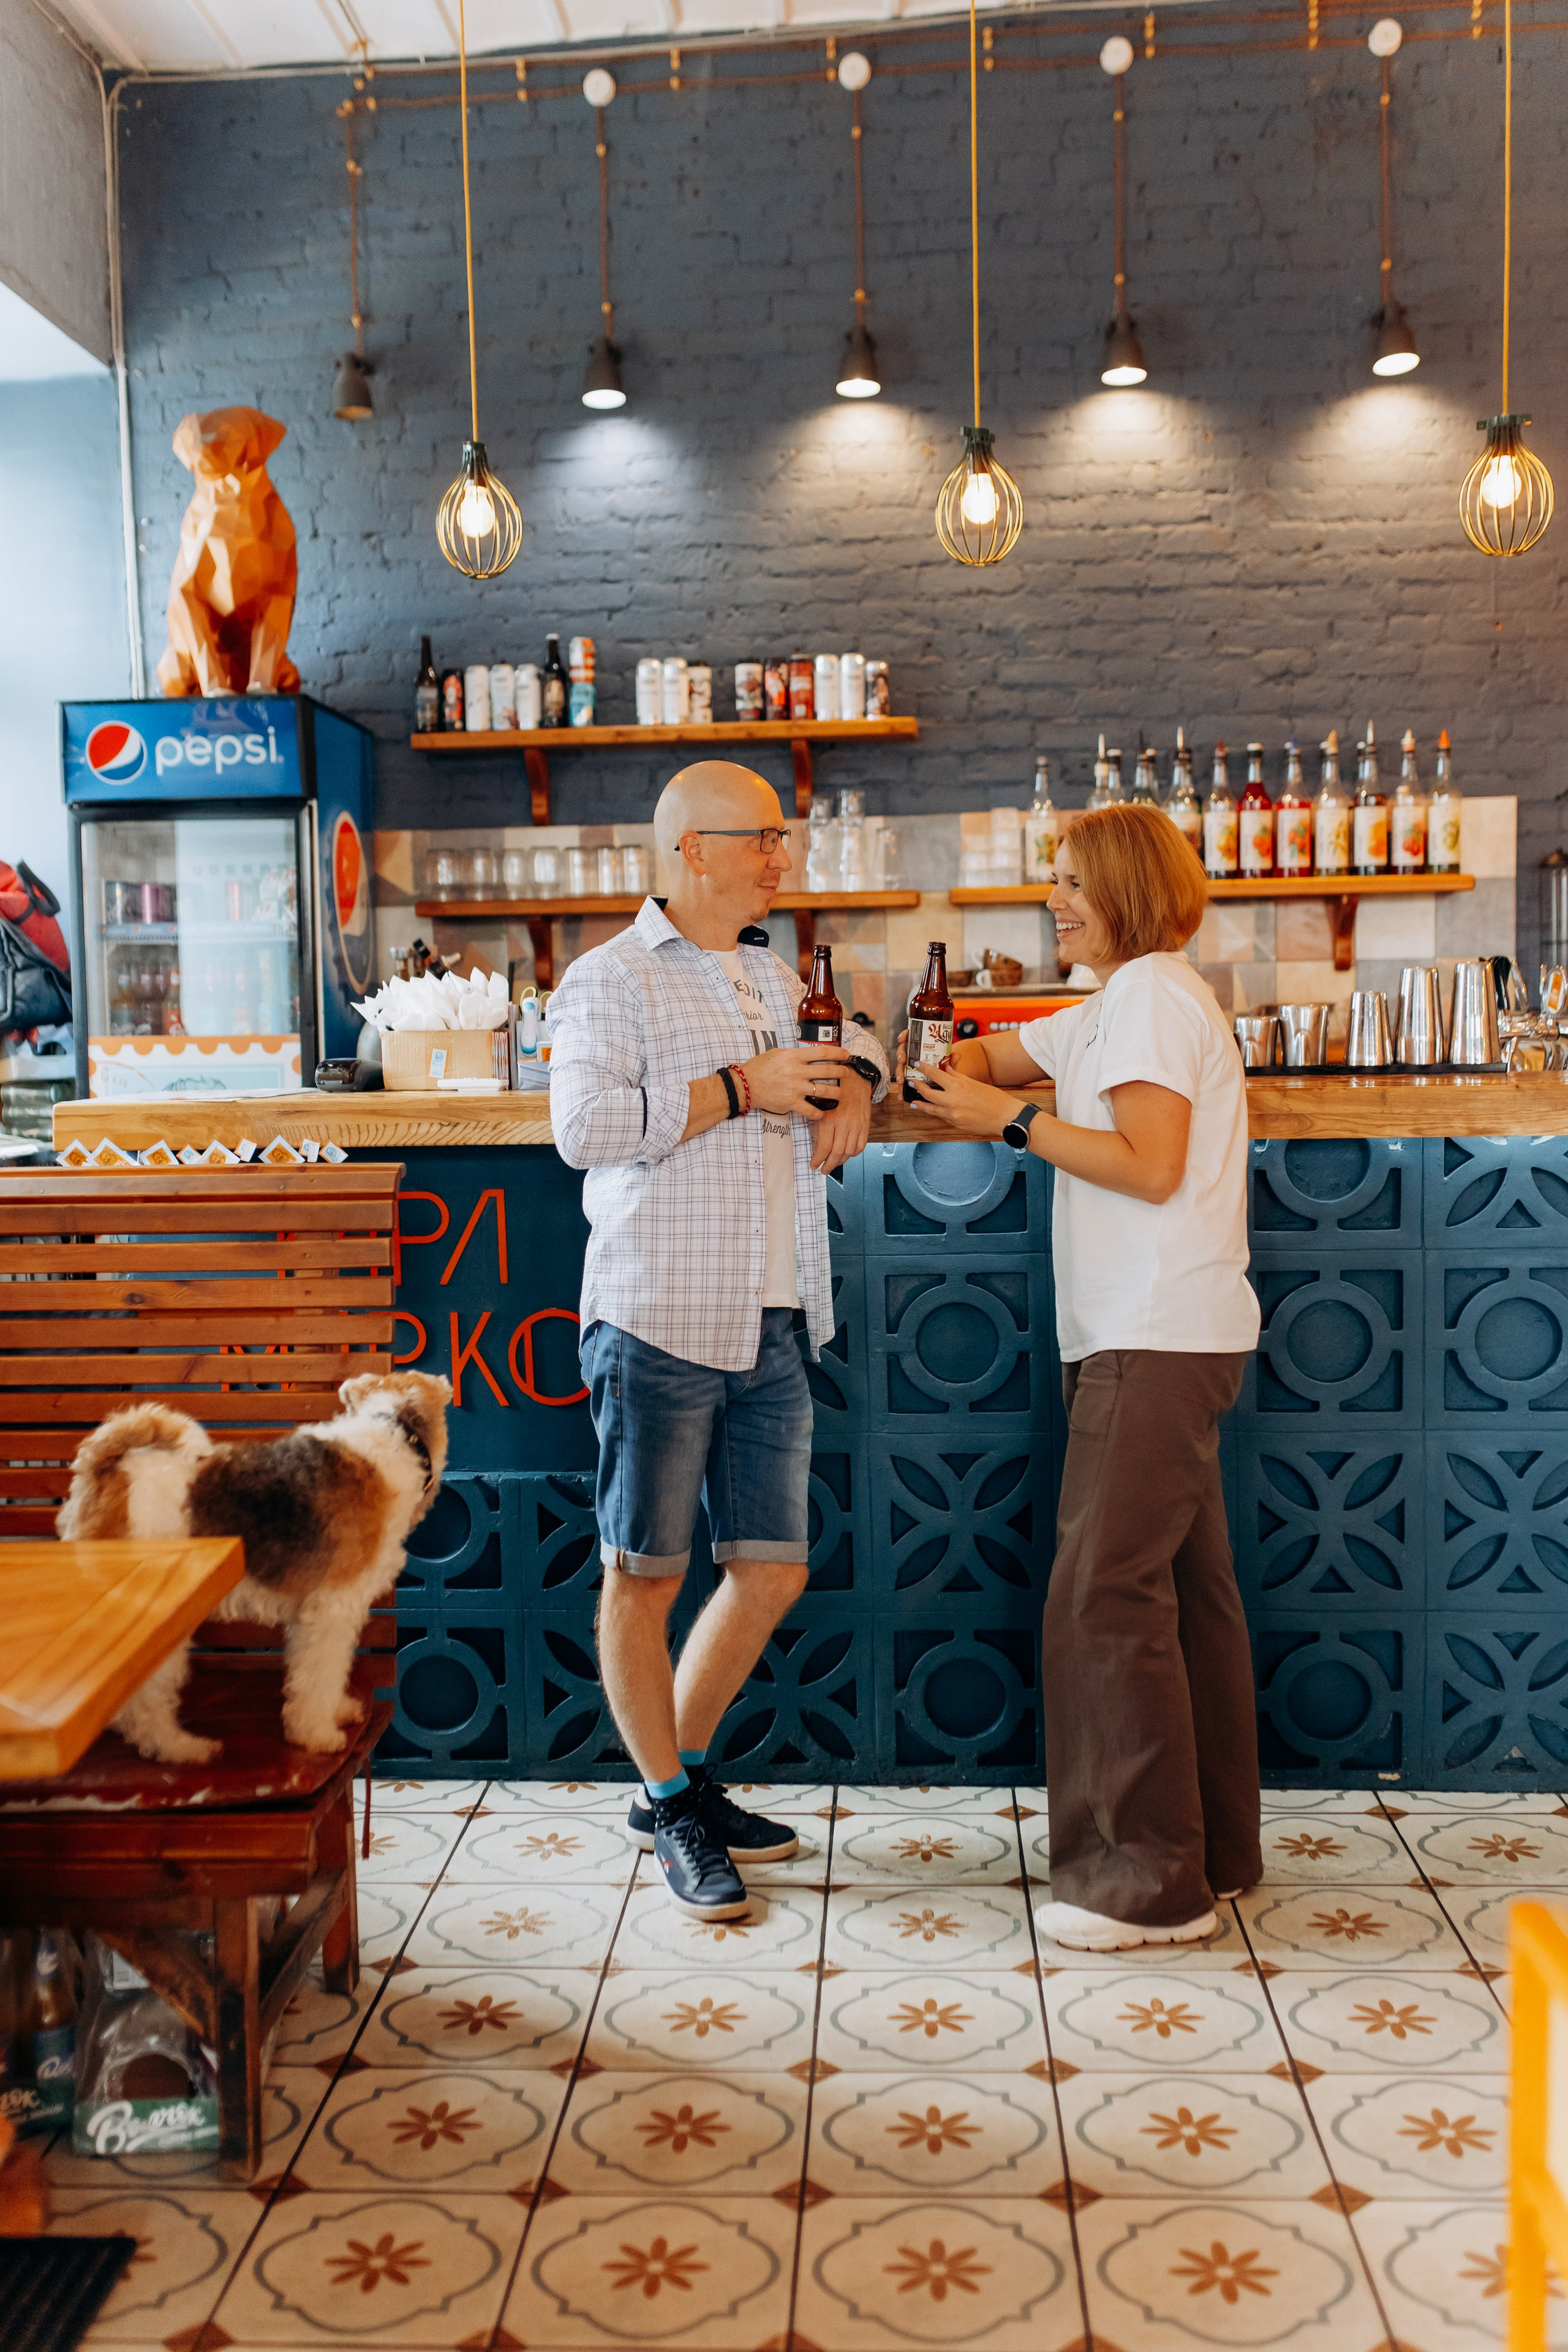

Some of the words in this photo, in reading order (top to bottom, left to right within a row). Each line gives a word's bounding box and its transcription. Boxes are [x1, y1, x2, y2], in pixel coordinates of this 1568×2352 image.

[155, 726, 276, 776] pepsi
[743, 1011, 764, 1020] rior
[763, 1118, 791, 1139] Strength
